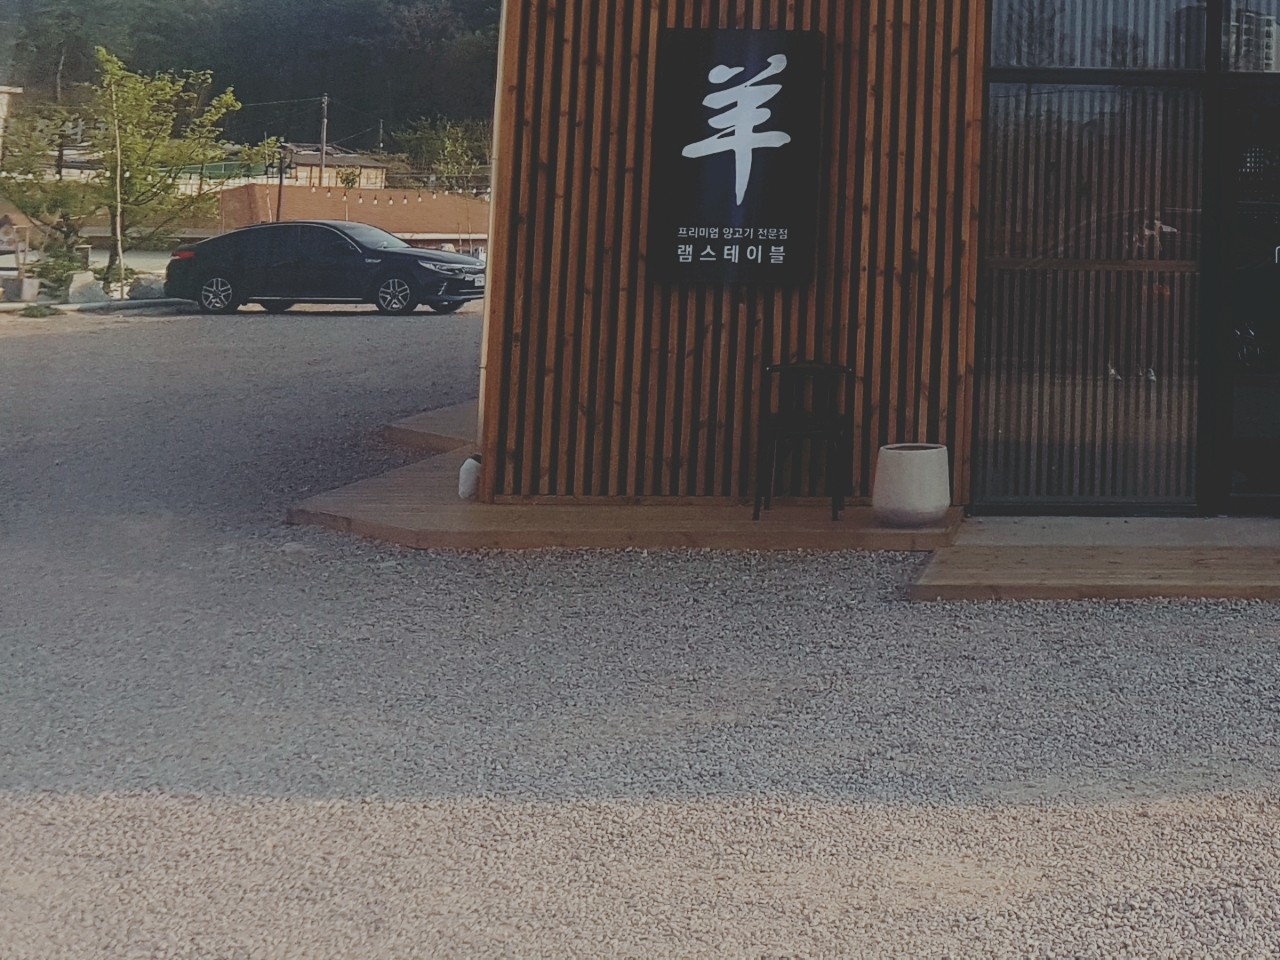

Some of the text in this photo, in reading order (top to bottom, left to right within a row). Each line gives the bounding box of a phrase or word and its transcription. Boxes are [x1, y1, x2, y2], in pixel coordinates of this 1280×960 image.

[681, 53, 792, 207] 羊
[677, 227, 789, 240] 프리미엄 양고기 전문점
[677, 244, 787, 264] 램스테이블
